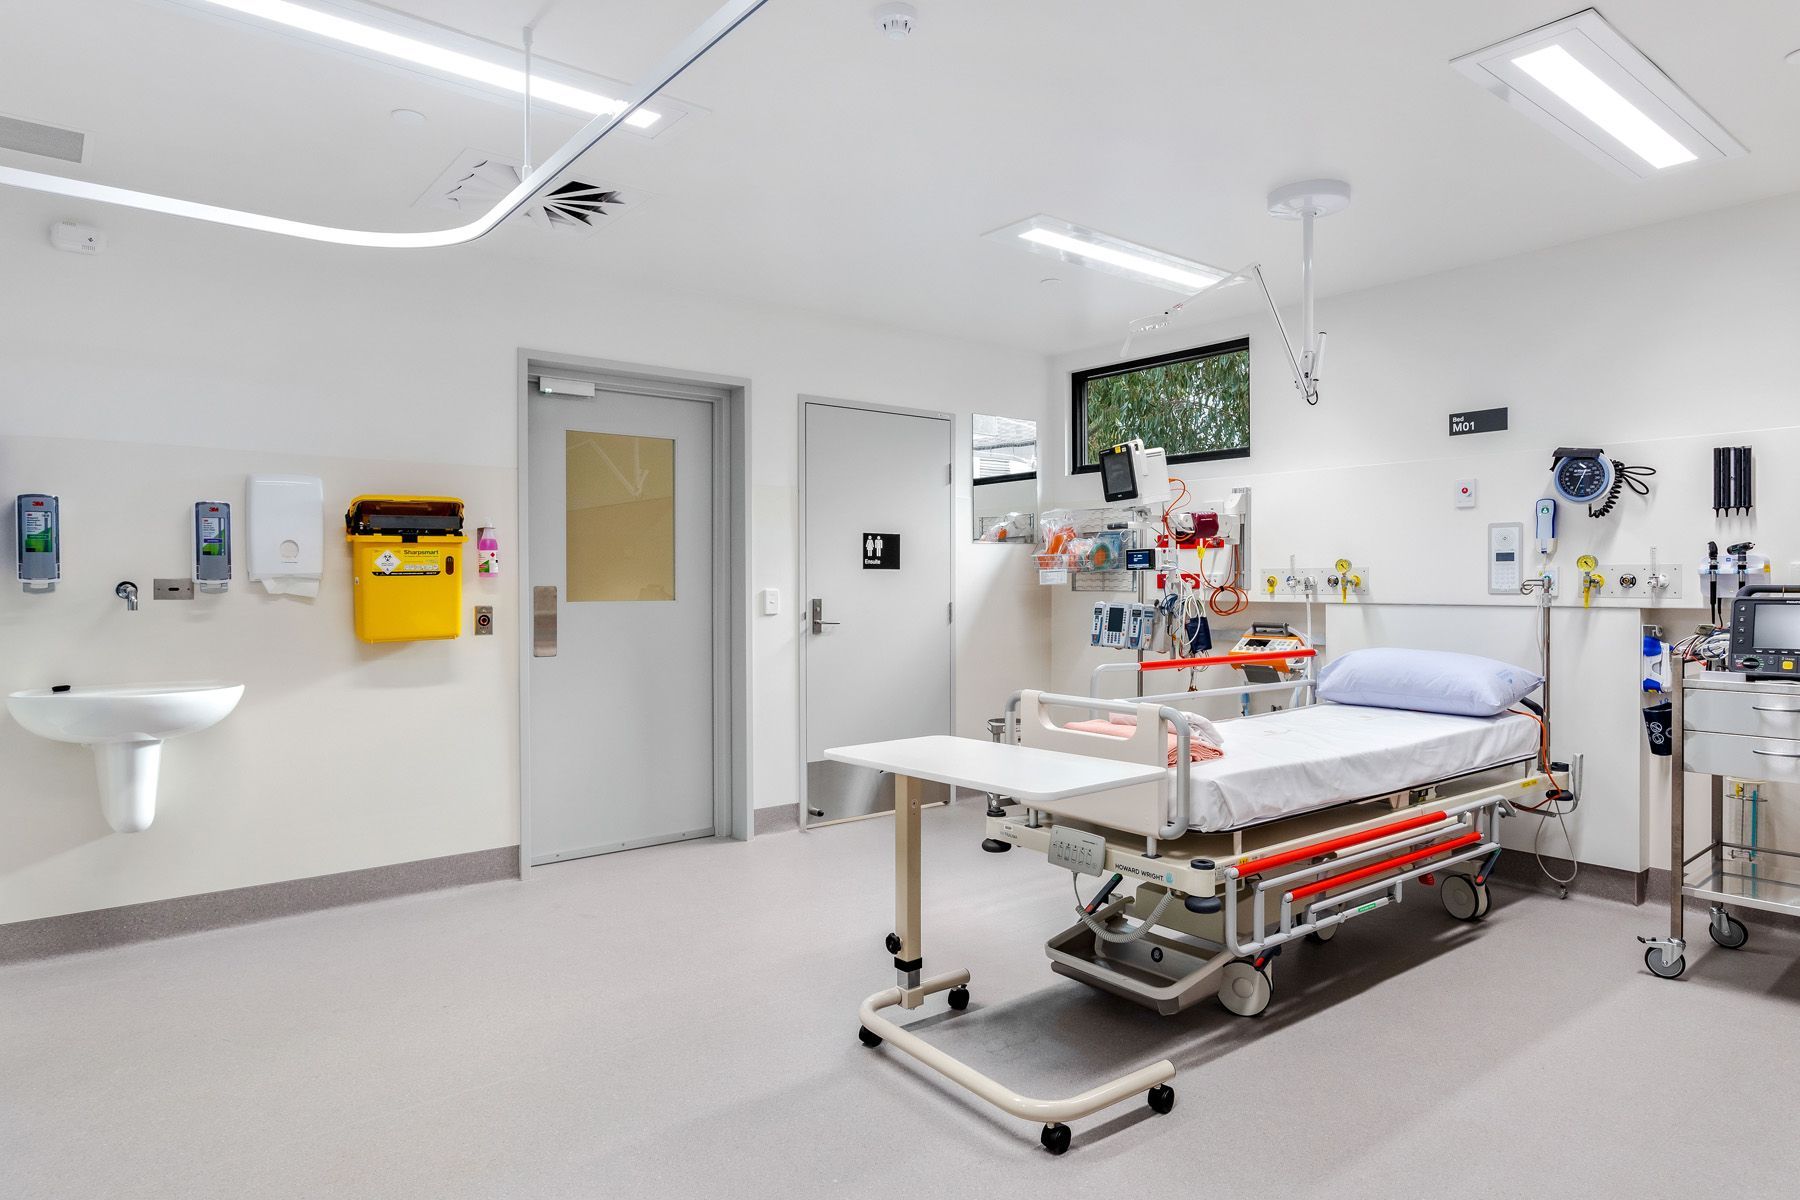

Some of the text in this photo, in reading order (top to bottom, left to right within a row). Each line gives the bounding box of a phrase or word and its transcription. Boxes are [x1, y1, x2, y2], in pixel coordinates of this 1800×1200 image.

[1453, 422, 1475, 432] M01
[1115, 864, 1163, 881] HOWARD WRIGHT
